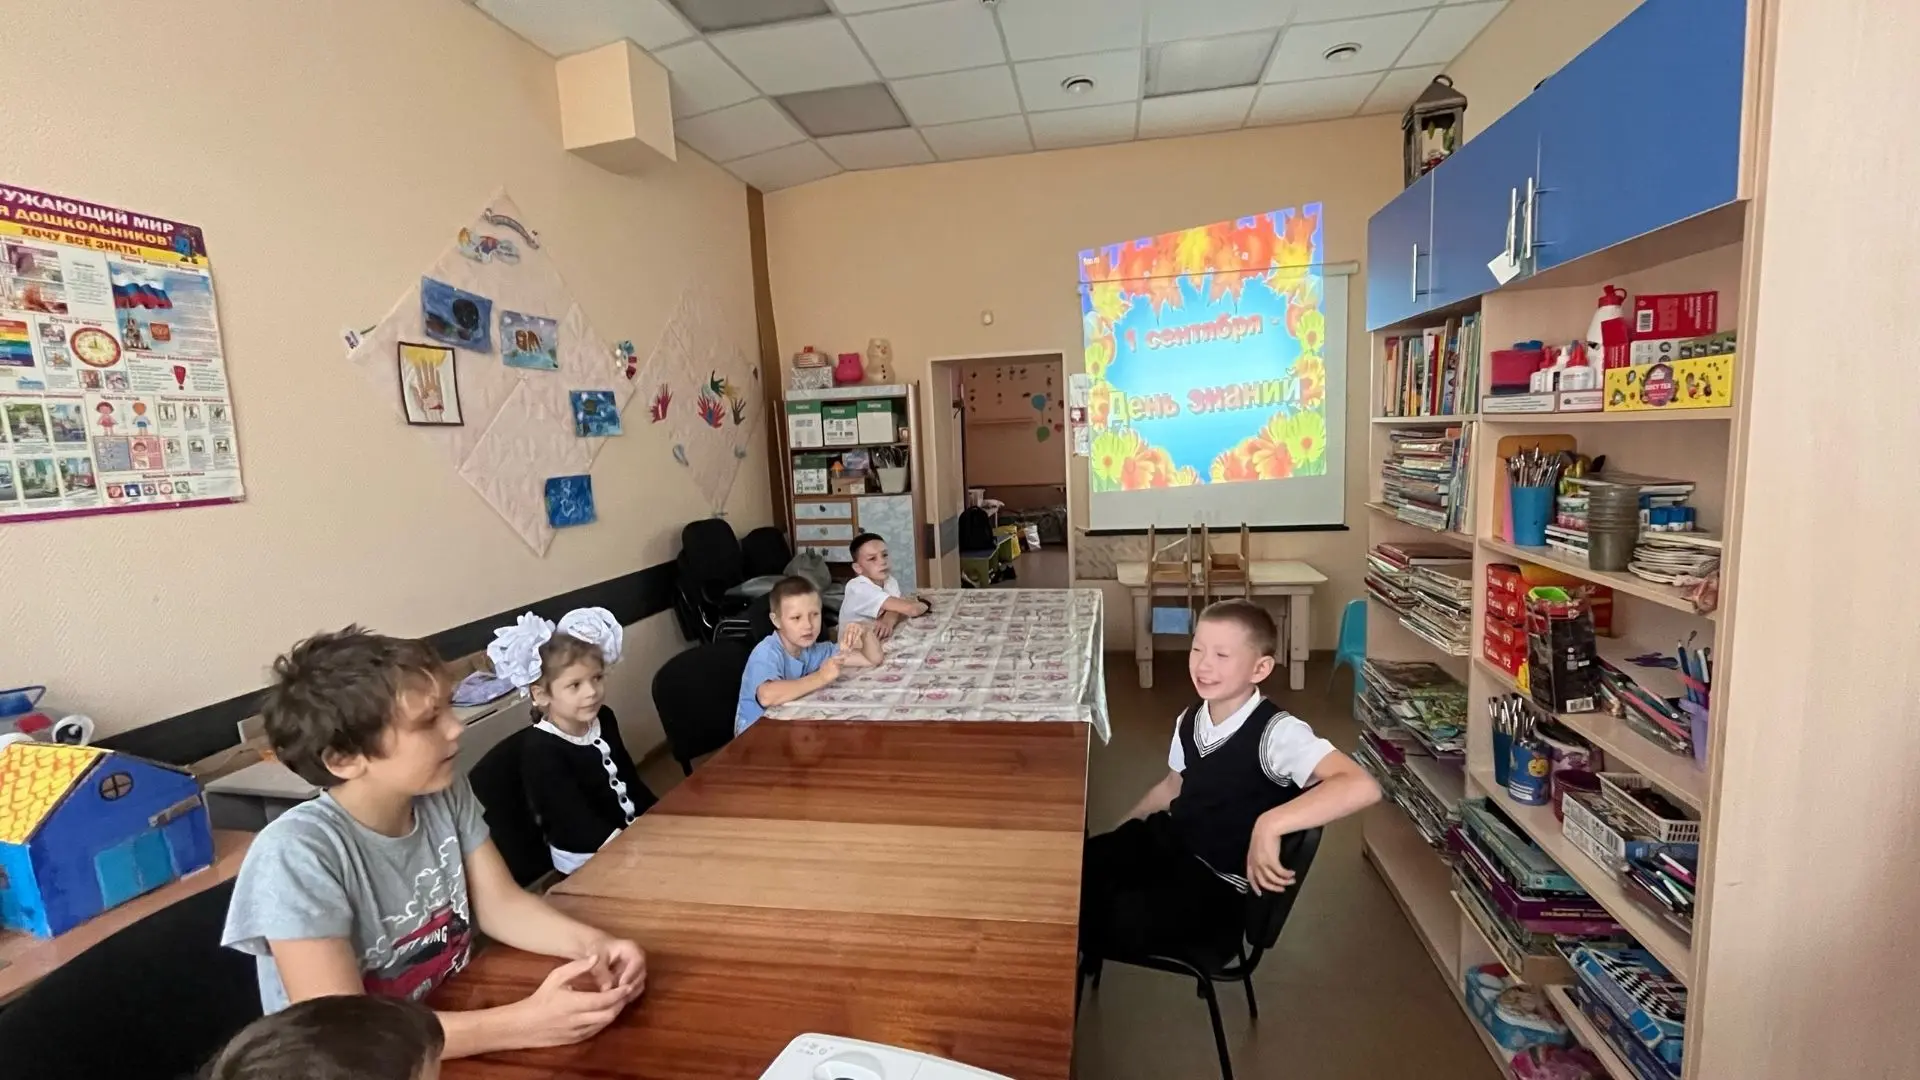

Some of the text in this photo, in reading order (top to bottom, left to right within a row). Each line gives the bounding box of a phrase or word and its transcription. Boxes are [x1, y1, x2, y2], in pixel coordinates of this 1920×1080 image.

[133, 216, 174, 233] МИР
[21, 226, 61, 241] ХОЧУ
[95, 238, 142, 256] ЗНАТЬ!
[1125, 328, 1137, 352] 1
[1145, 312, 1263, 350] сентября
[1107, 367, 1302, 429] День знаний
[1506, 582, 1515, 593] 12
[1507, 606, 1516, 617] 12
[1502, 656, 1511, 669] 12
